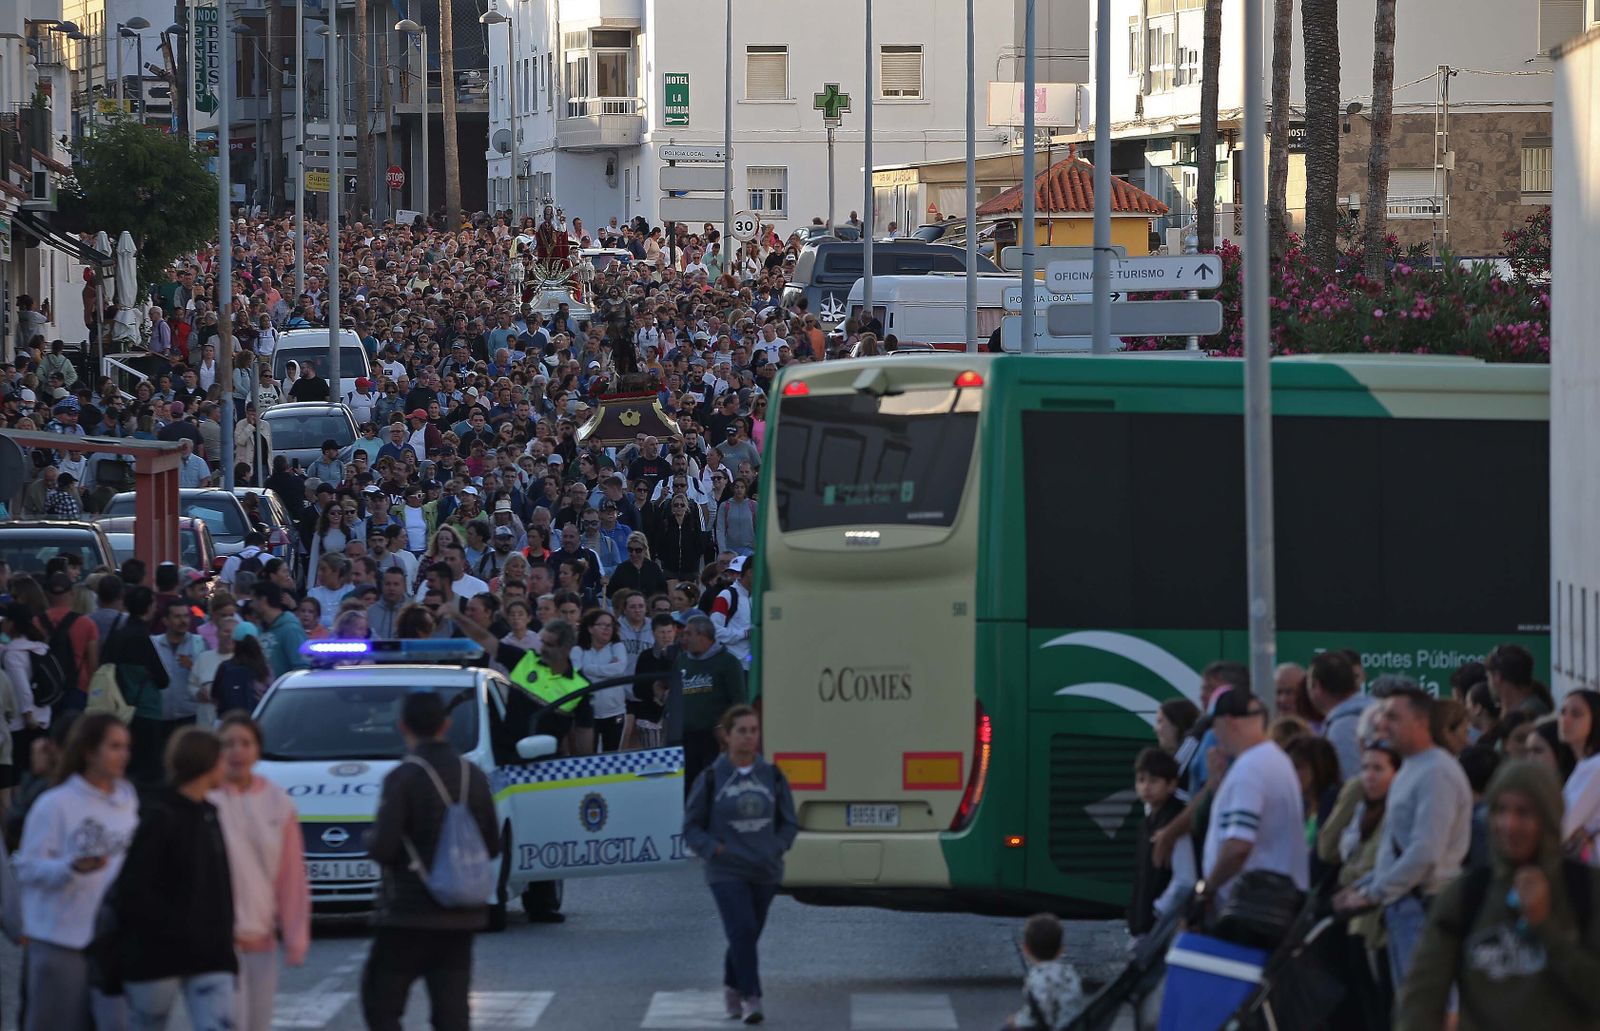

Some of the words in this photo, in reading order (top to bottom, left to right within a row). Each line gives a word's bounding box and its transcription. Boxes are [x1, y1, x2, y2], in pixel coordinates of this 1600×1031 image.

[207, 25, 219, 84] BEDS
[666, 76, 689, 85] HOTEL
[672, 93, 682, 103] LA
[665, 105, 689, 114] MIRADA
[387, 172, 405, 181] STOP
[735, 221, 754, 232] 30
[1054, 271, 1095, 281] OFICINA
[1116, 268, 1165, 279] TURISMO
[1009, 293, 1046, 304] POÍA
[286, 783, 381, 797] OLIC
[518, 836, 661, 871] POLICIA
